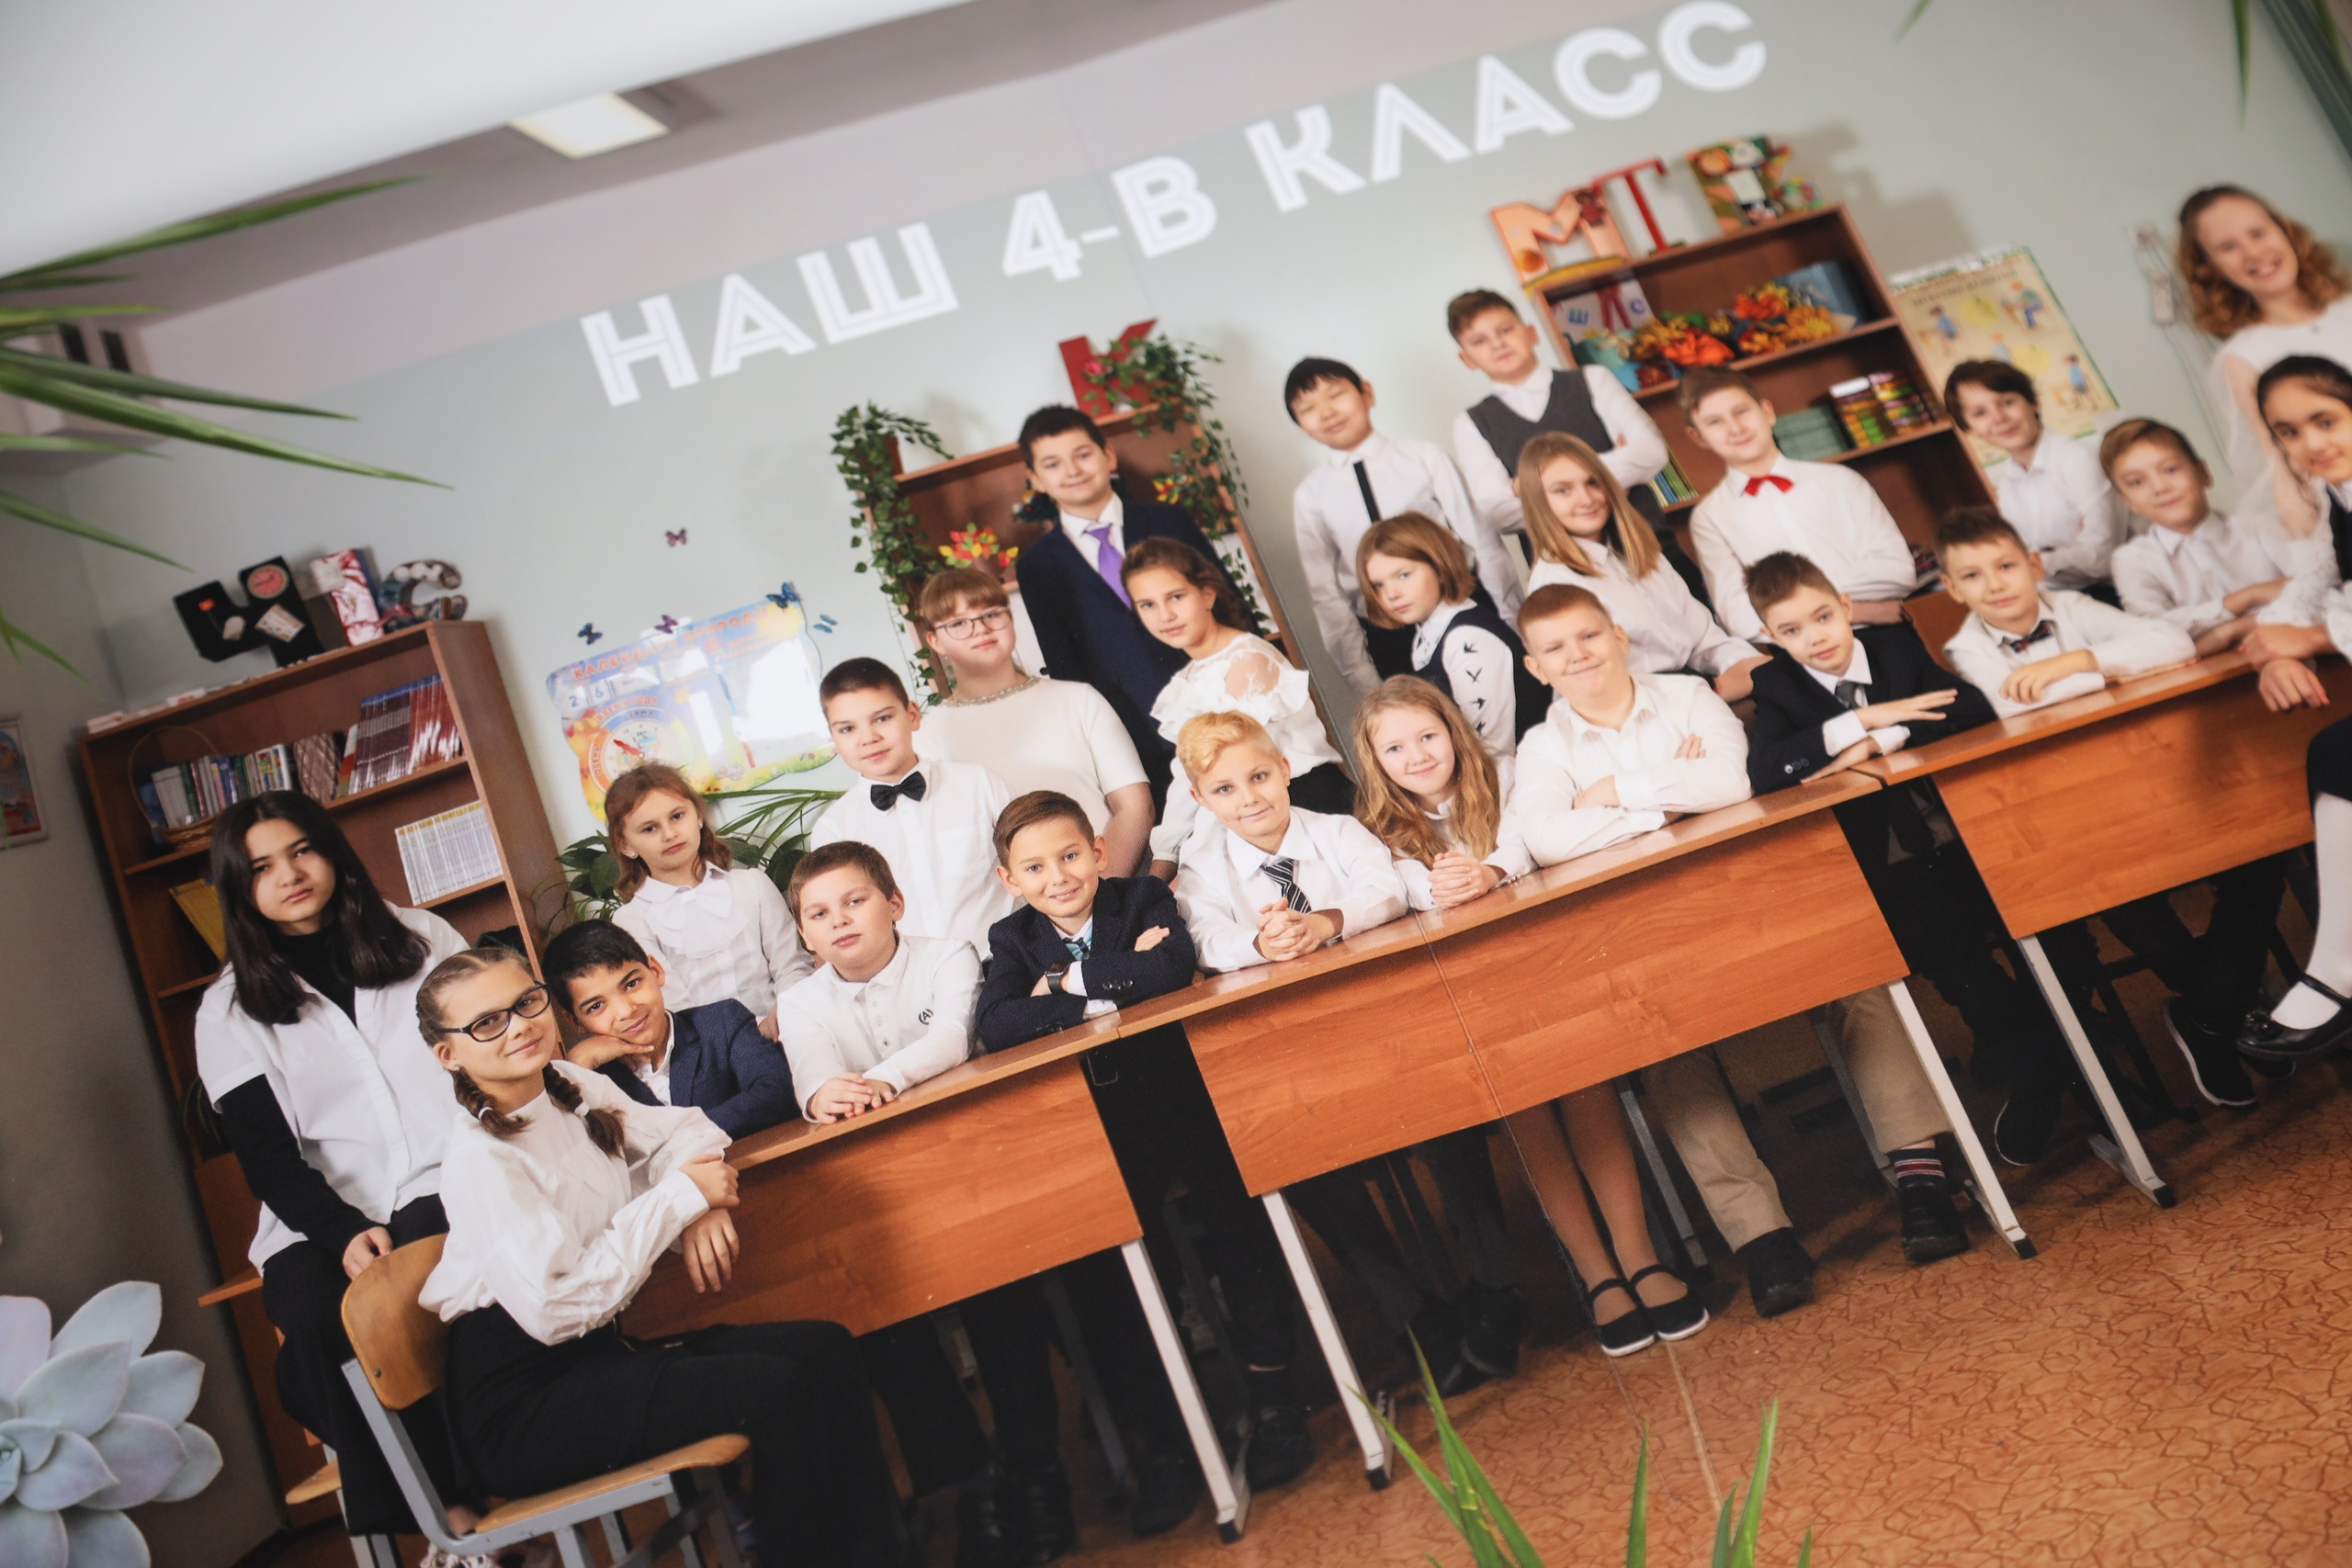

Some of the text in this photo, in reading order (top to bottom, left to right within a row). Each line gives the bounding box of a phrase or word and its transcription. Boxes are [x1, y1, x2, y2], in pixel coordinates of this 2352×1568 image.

[580, 0, 1767, 407] НАШ 4-В КЛАСС
